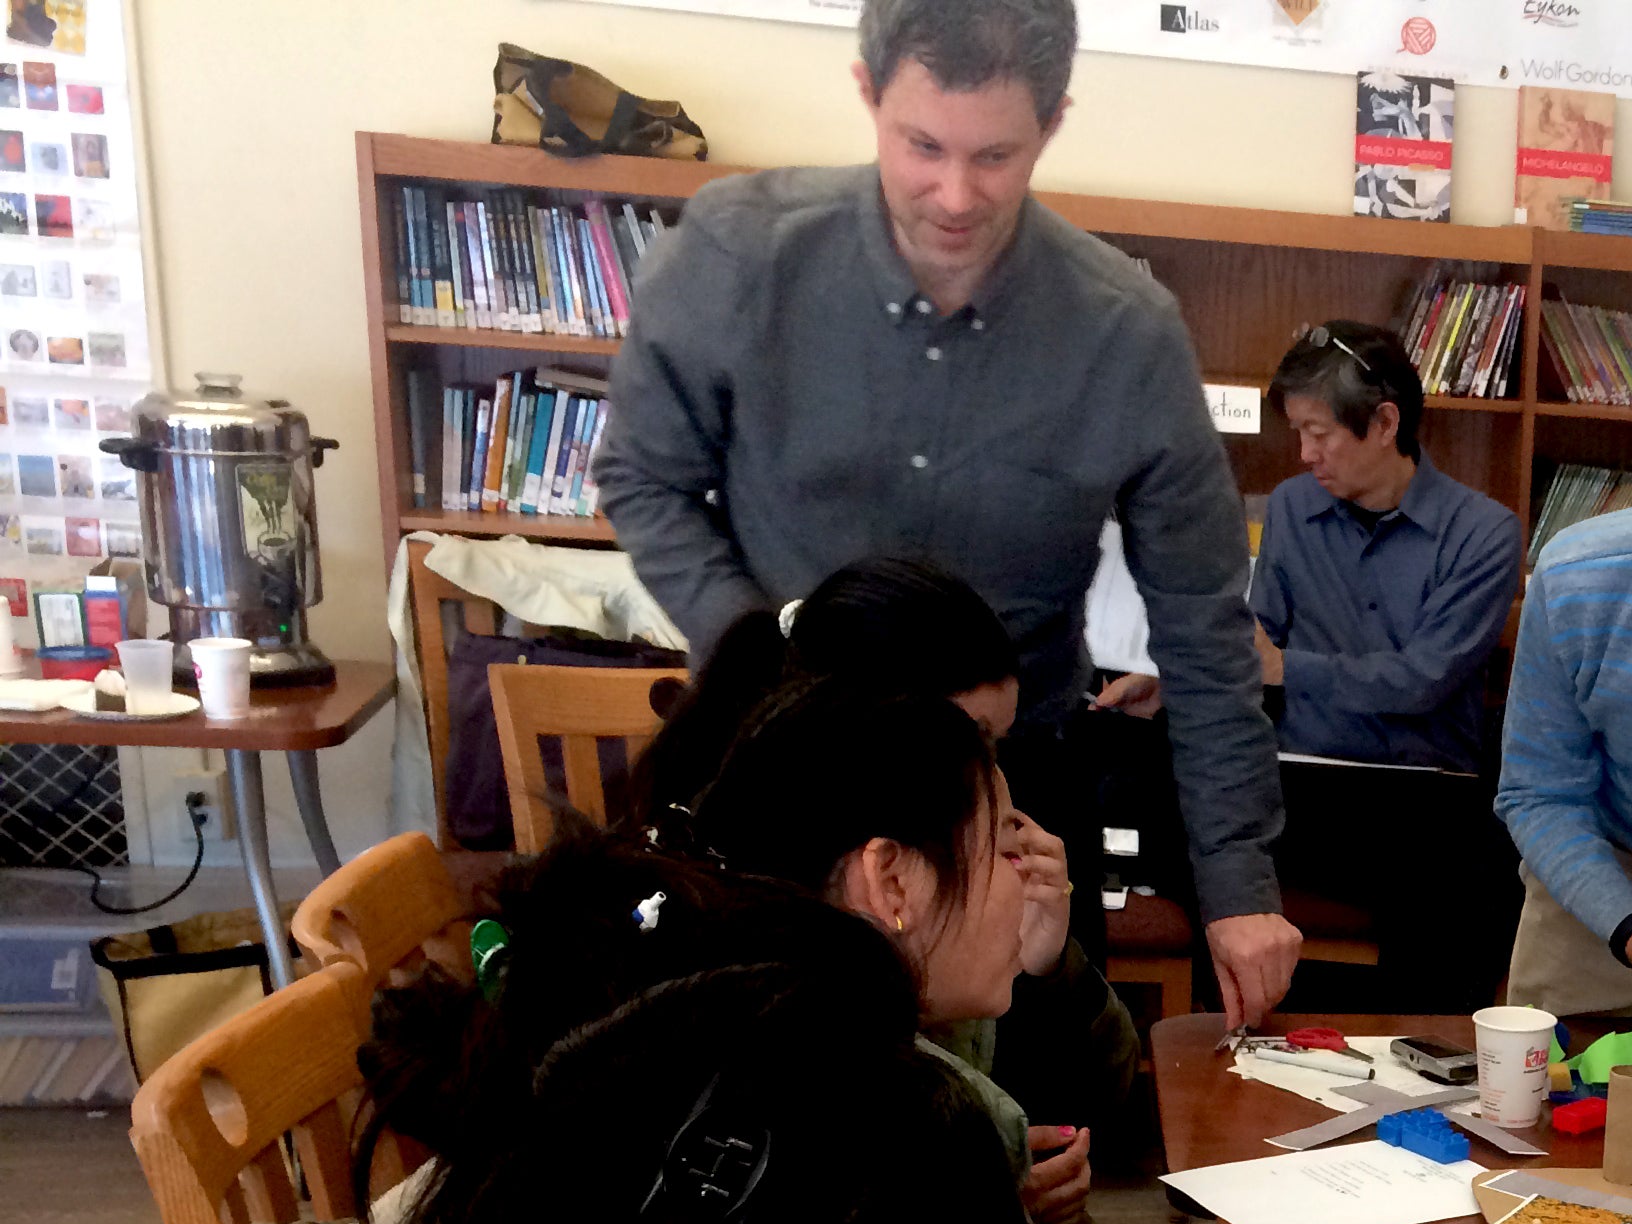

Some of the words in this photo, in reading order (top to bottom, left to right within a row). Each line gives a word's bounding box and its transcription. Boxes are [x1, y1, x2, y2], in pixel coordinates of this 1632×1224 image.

[1171, 9, 1220, 32] Atlas
[1359, 144, 1395, 158] PABLO
[1397, 147, 1444, 161] PICASSO
[1522, 157, 1604, 175] MICHELANGELO
